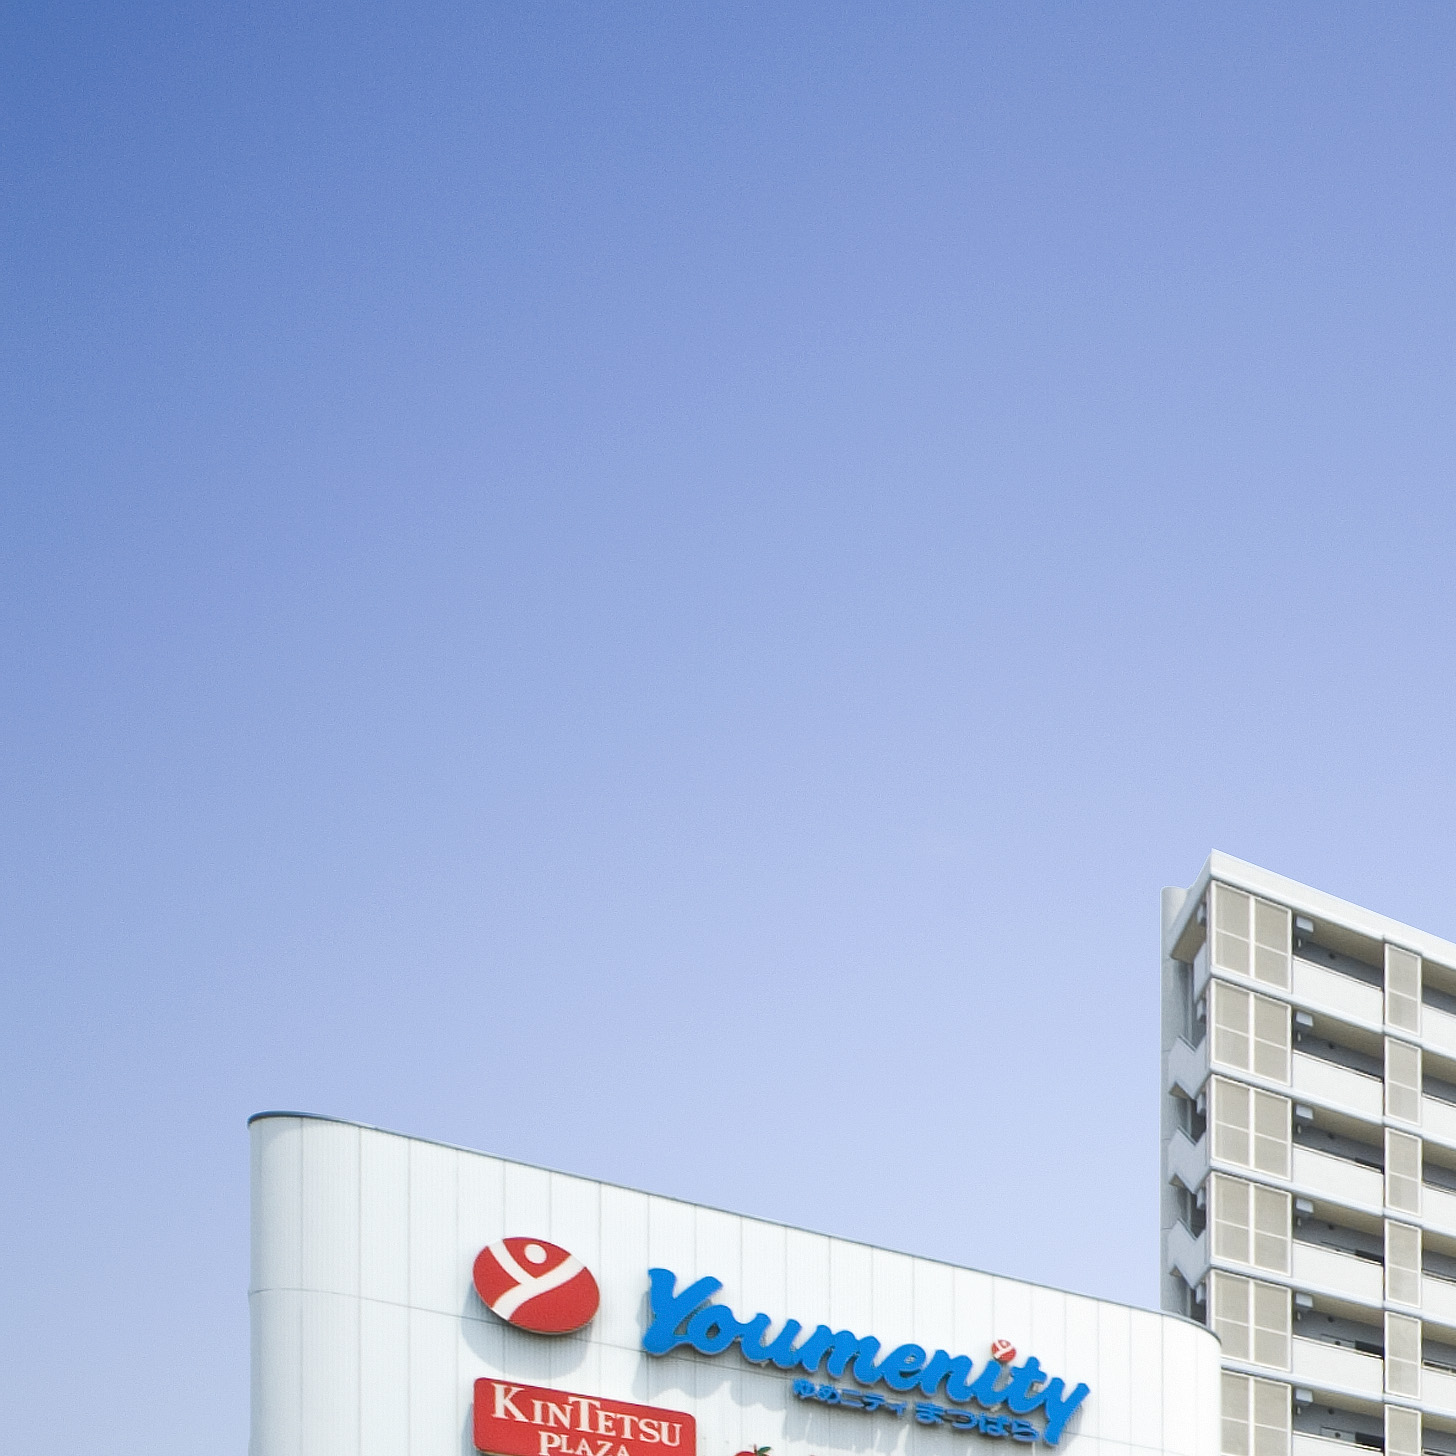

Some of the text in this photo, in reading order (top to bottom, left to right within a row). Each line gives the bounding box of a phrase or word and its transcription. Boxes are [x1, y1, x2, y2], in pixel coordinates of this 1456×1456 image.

[643, 1267, 1091, 1446] Youmenity
[915, 1401, 1040, 1443] まつばら
